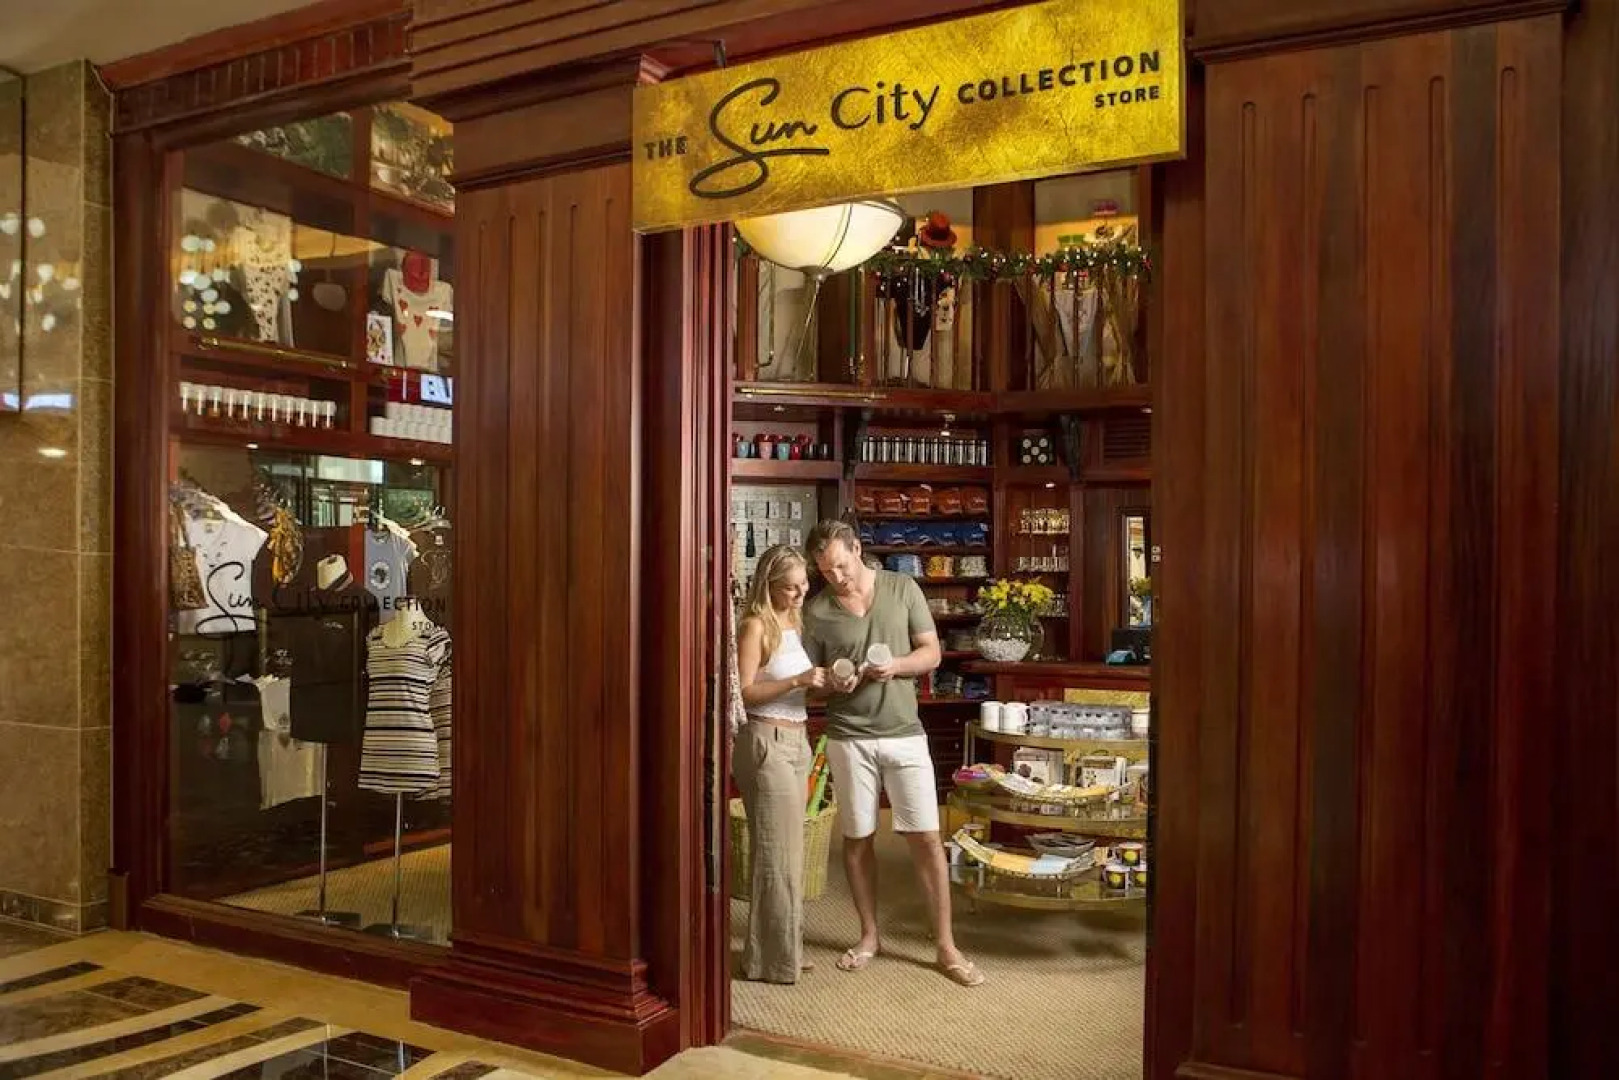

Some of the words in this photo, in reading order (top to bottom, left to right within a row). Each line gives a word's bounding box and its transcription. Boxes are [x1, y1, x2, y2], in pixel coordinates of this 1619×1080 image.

[643, 135, 688, 160] THE
[689, 77, 830, 199] Sun
[830, 81, 940, 130] City
[957, 50, 1160, 105] COLLECTION
[1094, 85, 1160, 109] STORE
